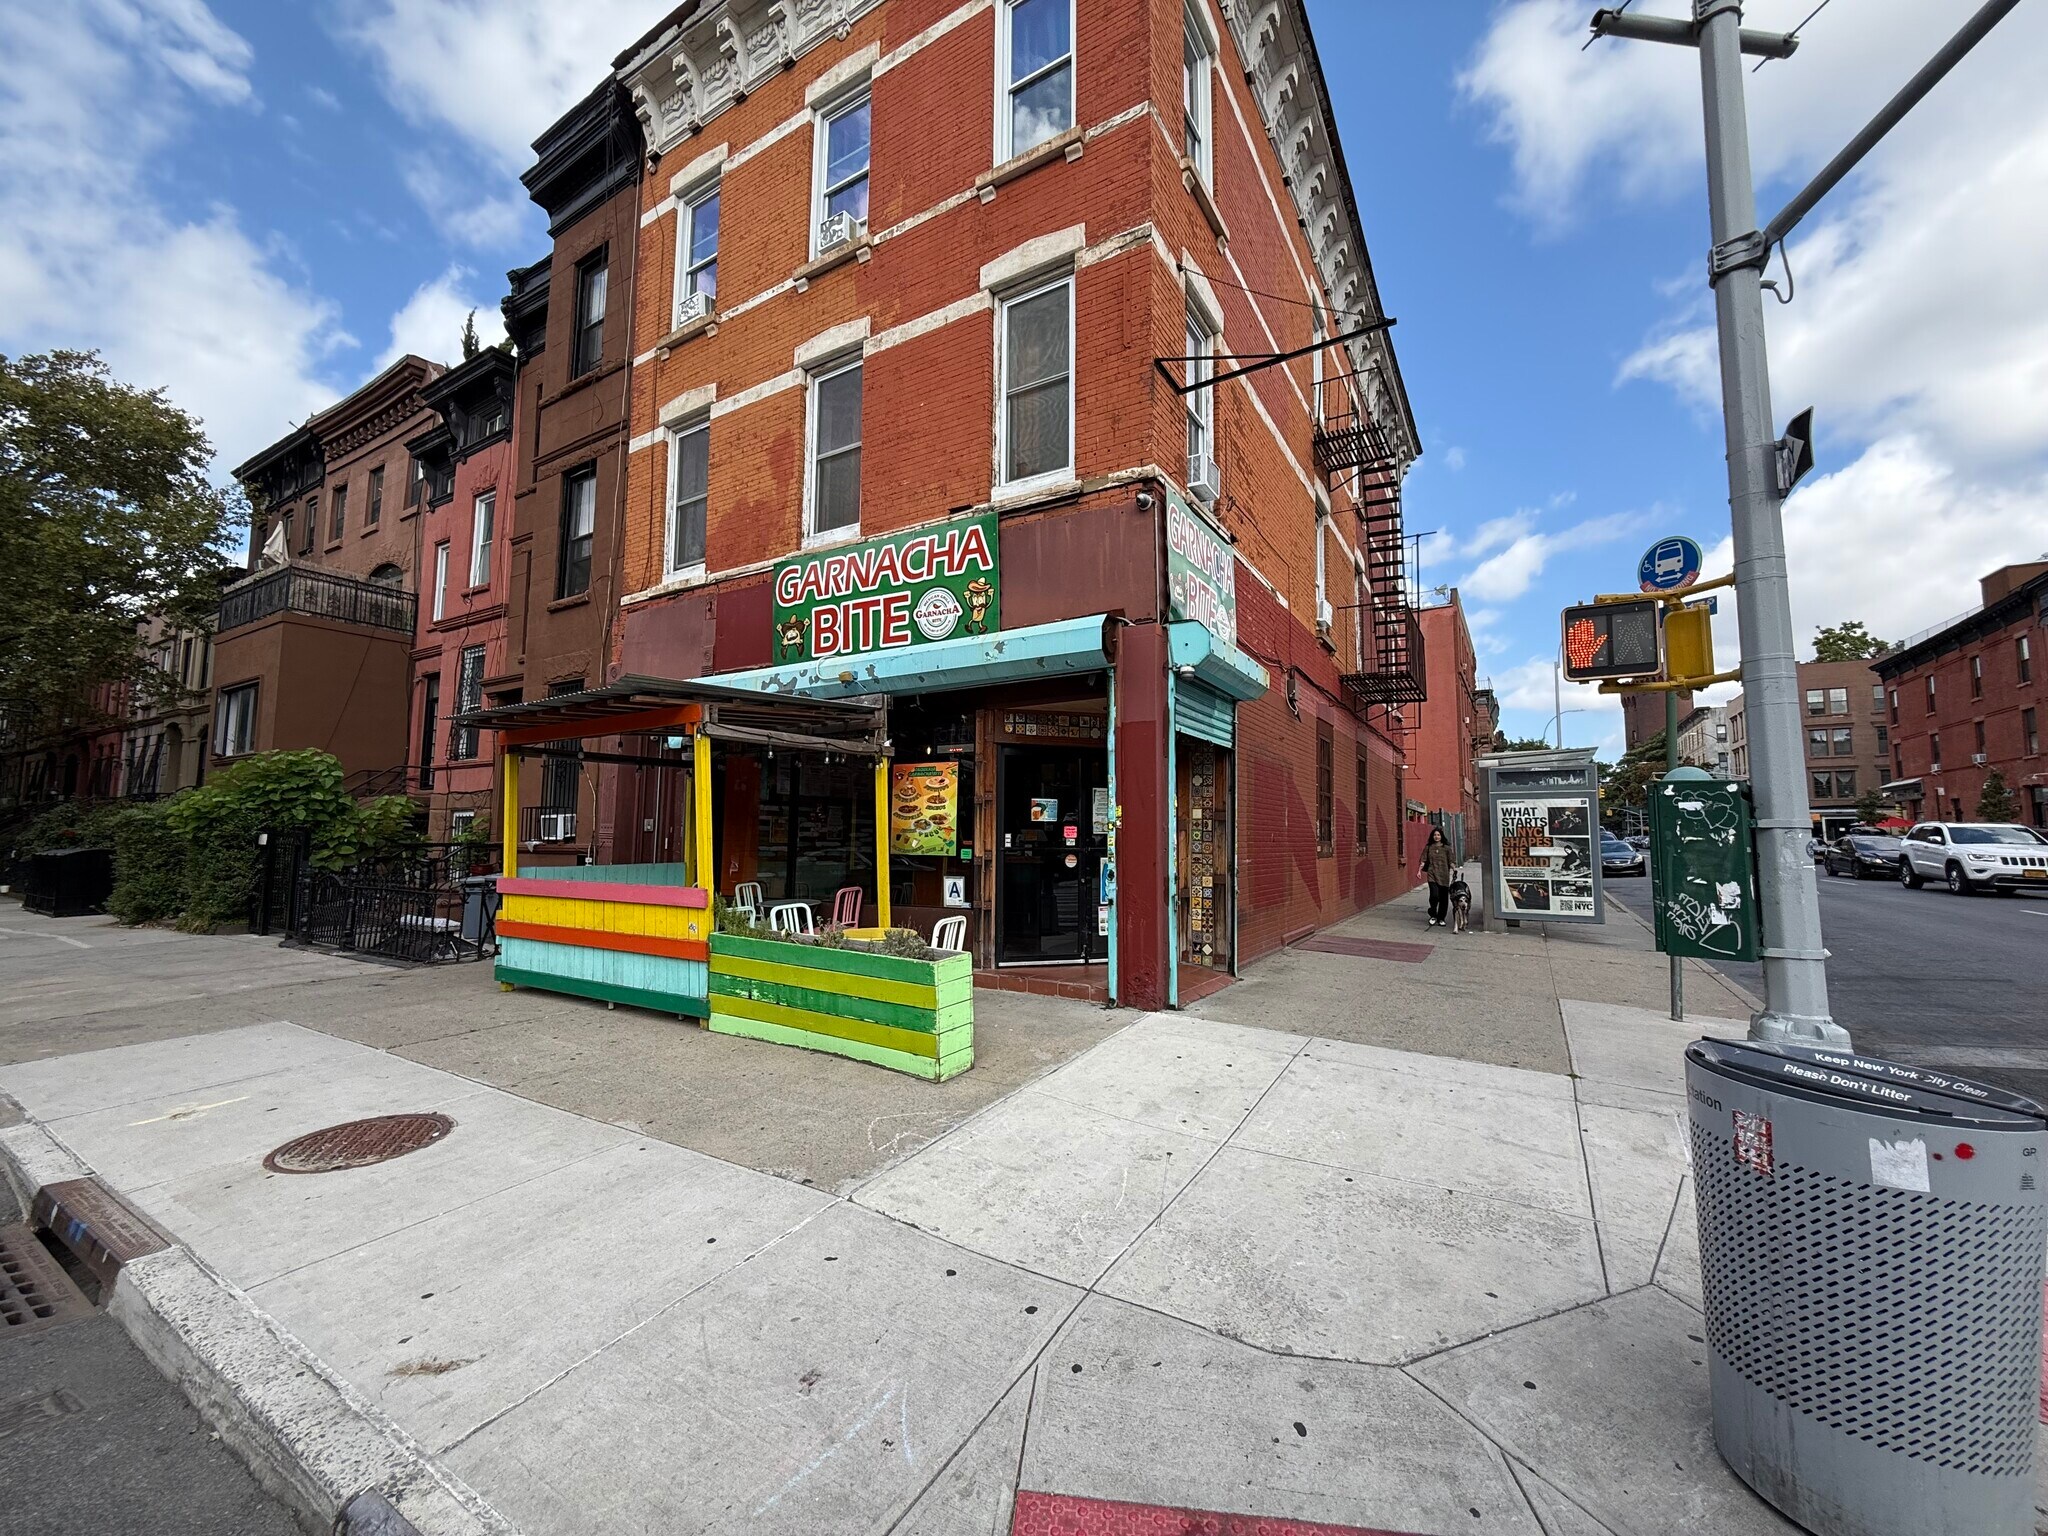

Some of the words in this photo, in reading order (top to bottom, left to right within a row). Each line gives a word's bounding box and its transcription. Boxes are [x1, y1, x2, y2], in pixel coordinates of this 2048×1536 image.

[1168, 502, 1236, 599] GARNACHA
[776, 526, 993, 606] GARNACHA
[923, 594, 940, 607] MEXICAN
[1186, 569, 1218, 633] BITE
[915, 604, 960, 619] GARNACHA
[811, 591, 911, 657] BITE
[1501, 807, 1538, 817] WHAT
[1502, 817, 1548, 828] STARTS
[1503, 827, 1515, 837] IN
[1517, 827, 1544, 837] NYC
[1502, 837, 1552, 847] SHAPES
[1502, 847, 1527, 857] THE
[1503, 857, 1550, 867] WORLD
[949, 881, 961, 898] A
[1574, 903, 1593, 911] NYC
[1814, 1052, 1850, 1066] Keep
[1853, 1059, 1885, 1072] New
[1888, 1066, 1919, 1080] York
[1952, 1082, 1989, 1098] Clean
[1783, 1063, 1828, 1081] Please
[1830, 1074, 1869, 1092] Don't
[1870, 1084, 1912, 1102] Litter
[2022, 1147, 2037, 1157] GP
